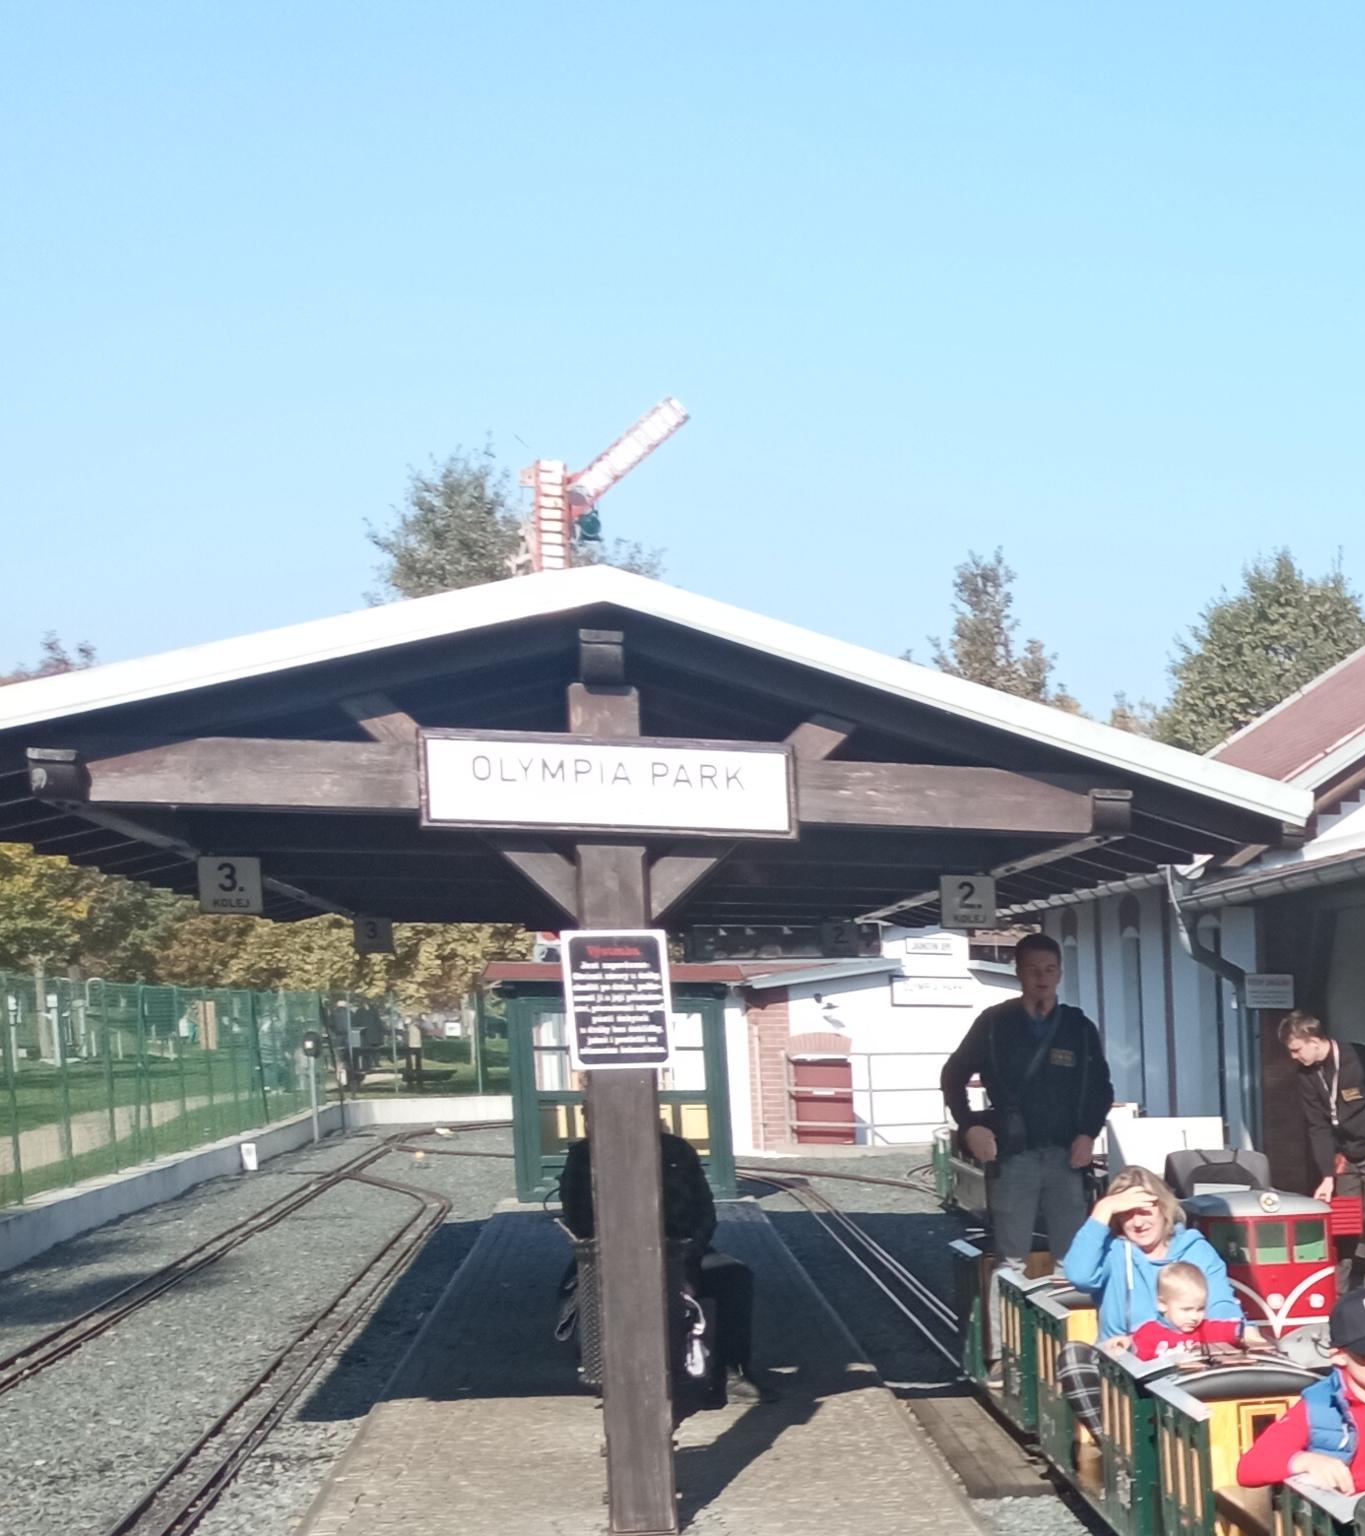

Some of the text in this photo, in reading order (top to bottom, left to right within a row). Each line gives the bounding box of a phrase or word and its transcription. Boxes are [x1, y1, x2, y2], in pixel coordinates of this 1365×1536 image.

[472, 755, 745, 790] OLYMPIA PARK
[217, 862, 245, 892] 3.
[212, 898, 251, 908] KOLEJ
[957, 881, 983, 909] 2.
